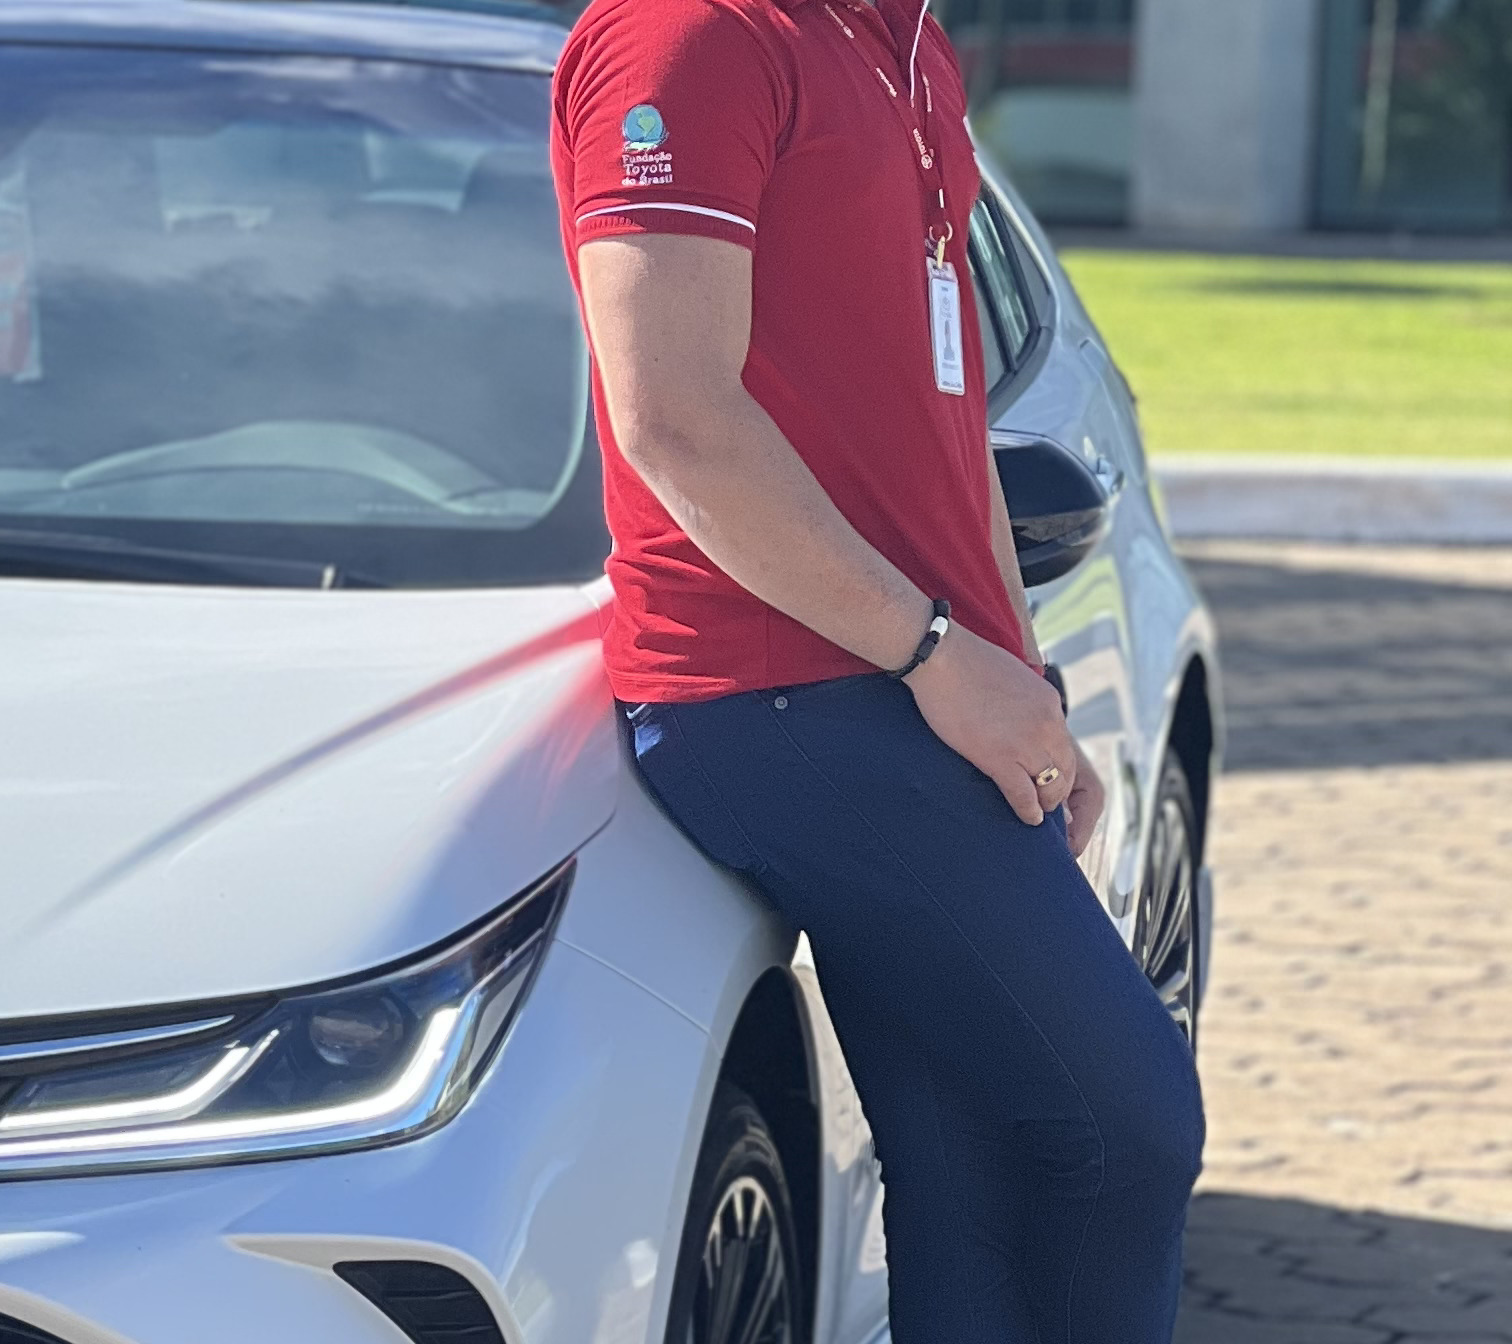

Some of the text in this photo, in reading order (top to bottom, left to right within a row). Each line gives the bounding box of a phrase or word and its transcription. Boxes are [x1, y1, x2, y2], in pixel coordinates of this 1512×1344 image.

[623, 163, 672, 177] Toyota
[622, 174, 673, 186] do Brasil
